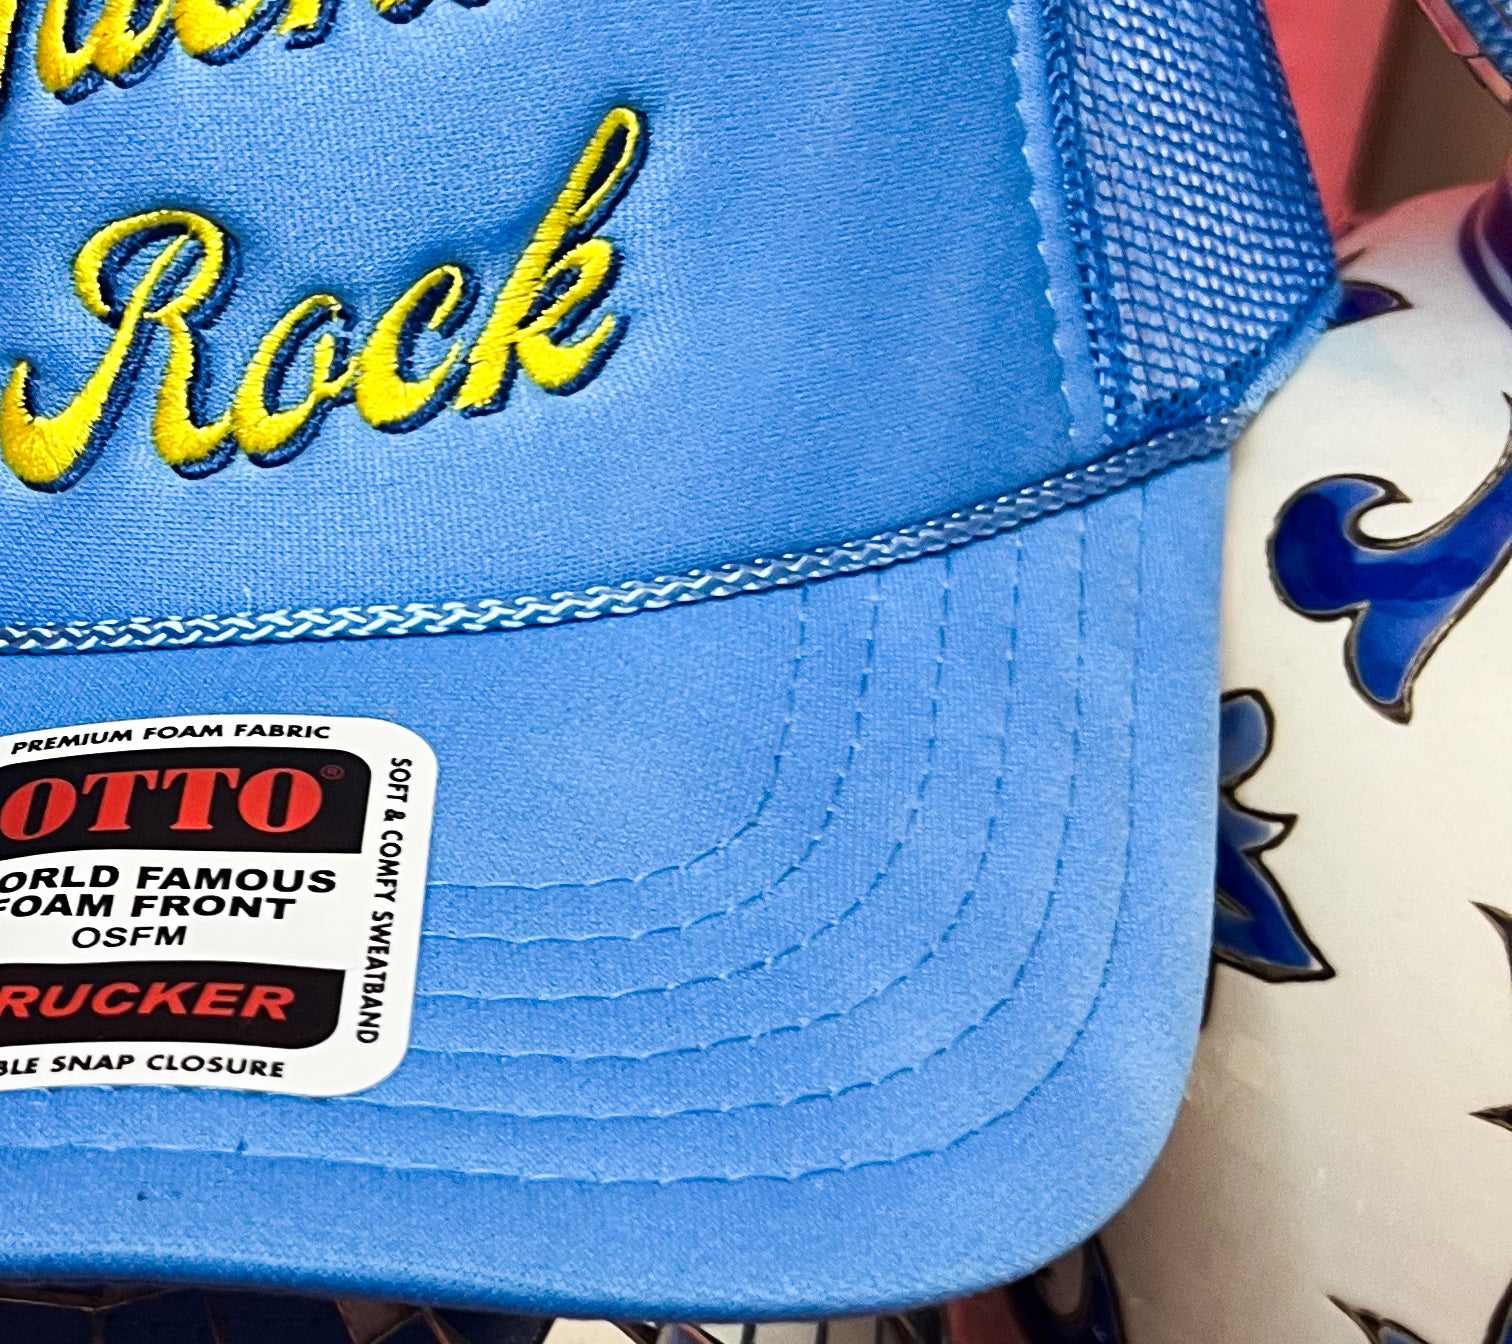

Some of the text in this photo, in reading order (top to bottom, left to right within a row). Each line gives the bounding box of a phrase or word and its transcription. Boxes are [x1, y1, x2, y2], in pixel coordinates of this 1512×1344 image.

[11, 723, 332, 755] PREMIUM FOAM FABRIC
[136, 866, 336, 893] FAMOUS
[131, 895, 296, 920] FRONT
[356, 757, 411, 1044] SOFT & COMFY SWEATBAND
[72, 926, 187, 948] OSFM
[50, 1054, 136, 1072] SNAP
[146, 1054, 286, 1078] CLOSURE
